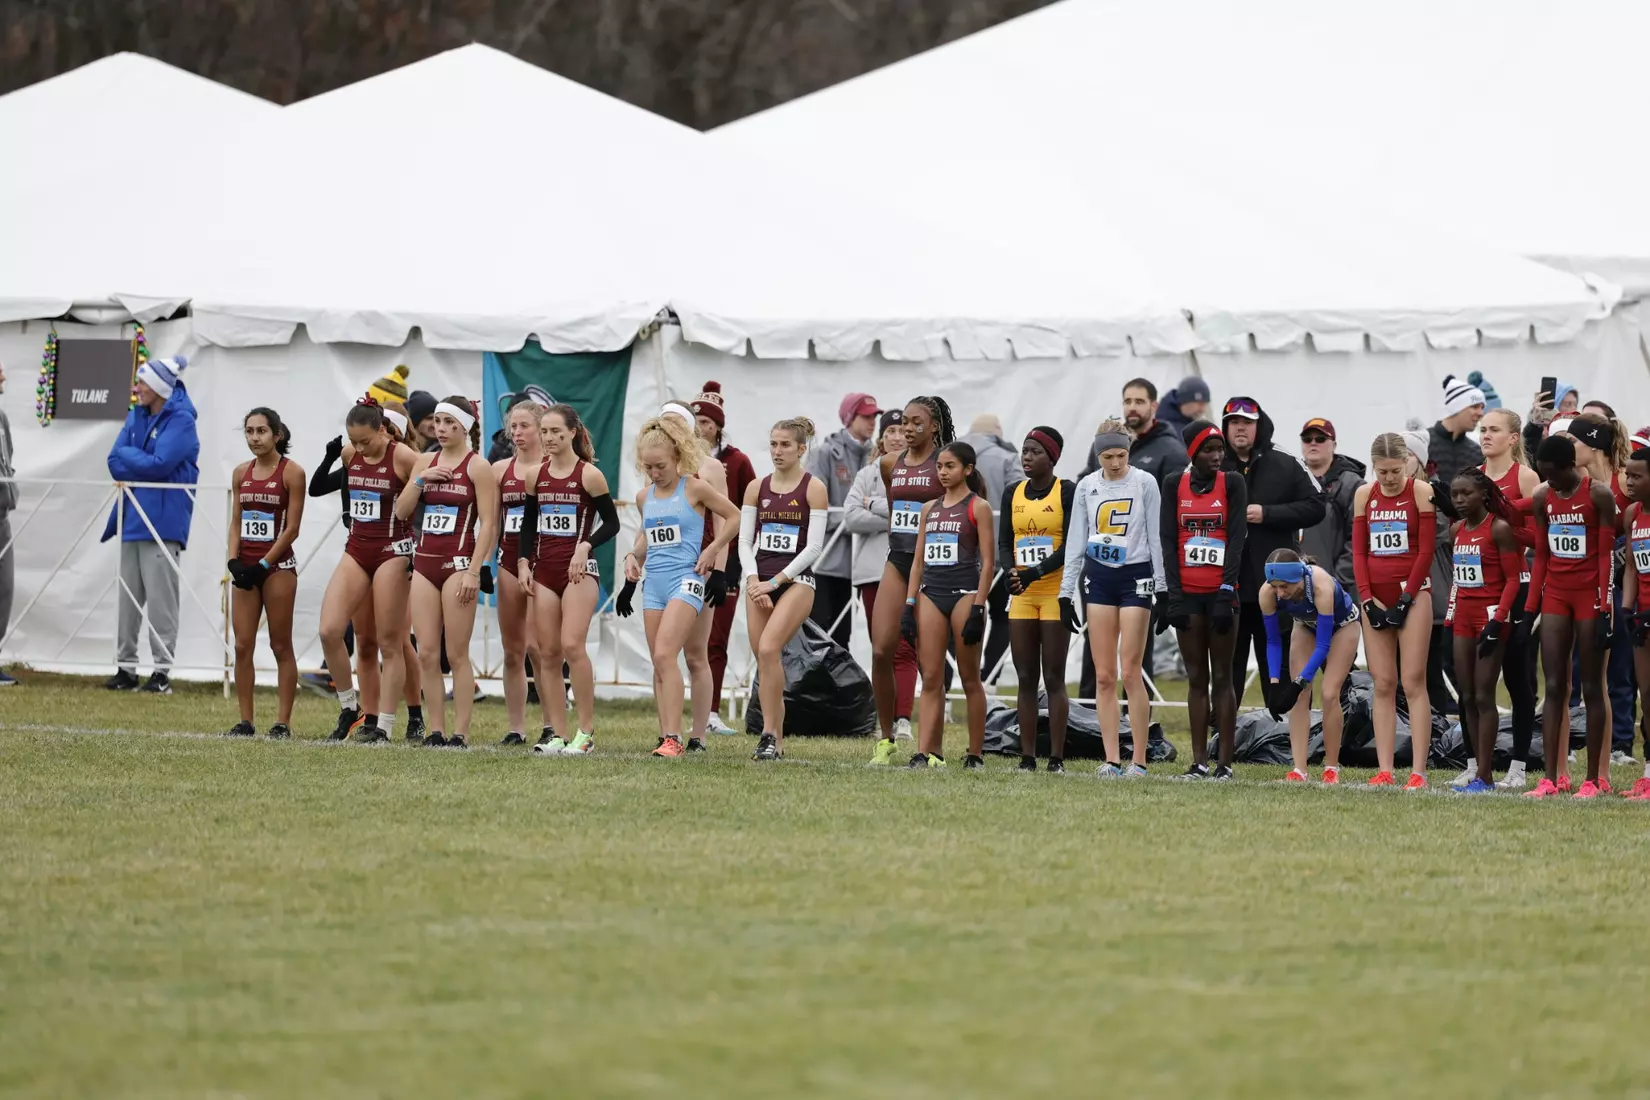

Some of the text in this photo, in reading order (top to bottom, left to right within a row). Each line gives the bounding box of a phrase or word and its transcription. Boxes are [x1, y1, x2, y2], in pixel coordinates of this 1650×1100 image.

[71, 389, 109, 403] TULANE
[364, 478, 390, 489] COLLEGE
[907, 476, 931, 486] STATE
[438, 485, 468, 496] COLLEGE
[254, 494, 280, 504] COLLEGE
[555, 493, 580, 503] COLLEGE
[354, 501, 374, 516] 131
[1370, 510, 1407, 520] ALABAMA
[427, 515, 450, 529] 137
[545, 516, 570, 530] 138
[778, 511, 802, 521] MICHIGAN
[895, 512, 919, 527] 314
[1096, 498, 1133, 536] C
[1549, 513, 1585, 524] ALABAMA
[245, 522, 268, 536] 139
[939, 520, 962, 532] STATE
[651, 527, 675, 543] 160
[766, 534, 791, 549] 153
[1375, 533, 1402, 549] 103
[1554, 537, 1579, 551] 108
[928, 545, 952, 559] 315
[1021, 547, 1047, 563] 115
[1093, 545, 1120, 562] 154
[1189, 547, 1218, 563] 416
[1456, 566, 1477, 581] 113
[687, 582, 704, 597] 160
